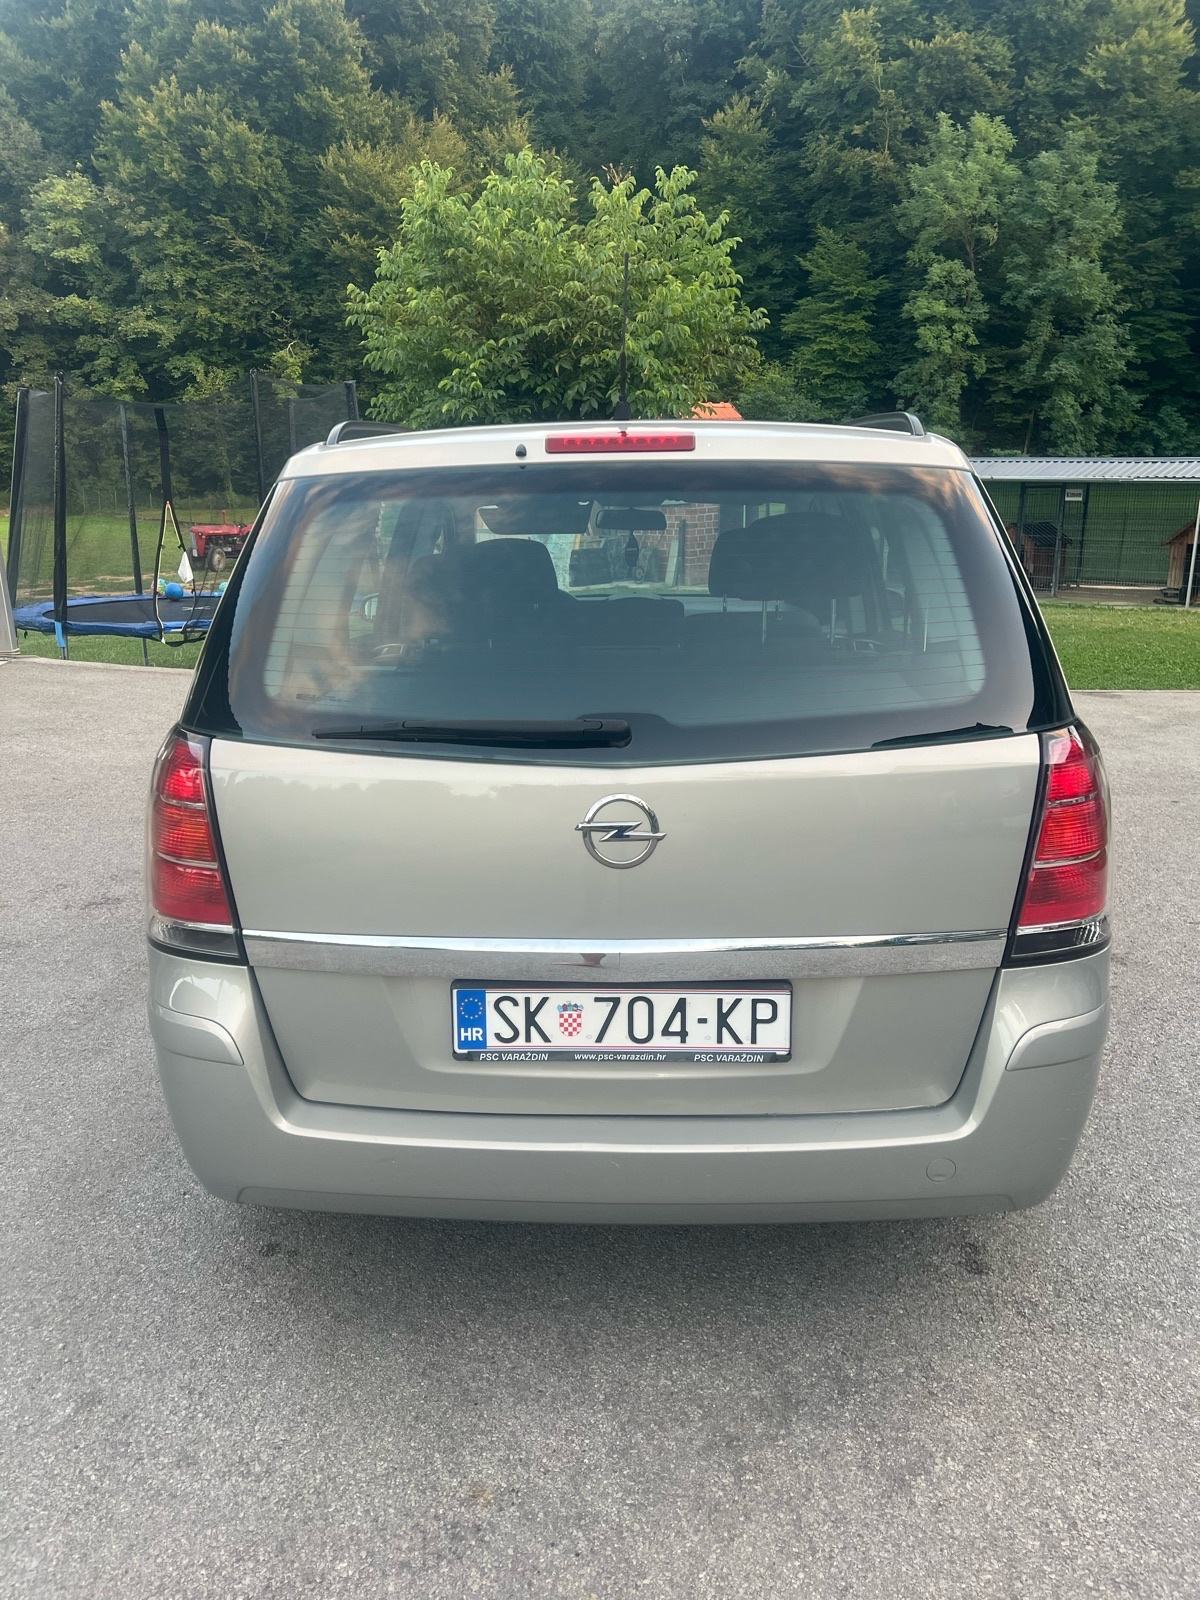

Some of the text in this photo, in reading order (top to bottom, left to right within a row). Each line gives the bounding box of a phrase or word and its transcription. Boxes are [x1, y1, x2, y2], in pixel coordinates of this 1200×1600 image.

[493, 995, 778, 1045] SK 704-KP
[460, 1027, 483, 1042] HR
[479, 1051, 549, 1061] PSC VARAŽDIN
[574, 1052, 667, 1062] www.psc-varazdin.hr
[694, 1053, 764, 1063] PSC VARAŽDIN
